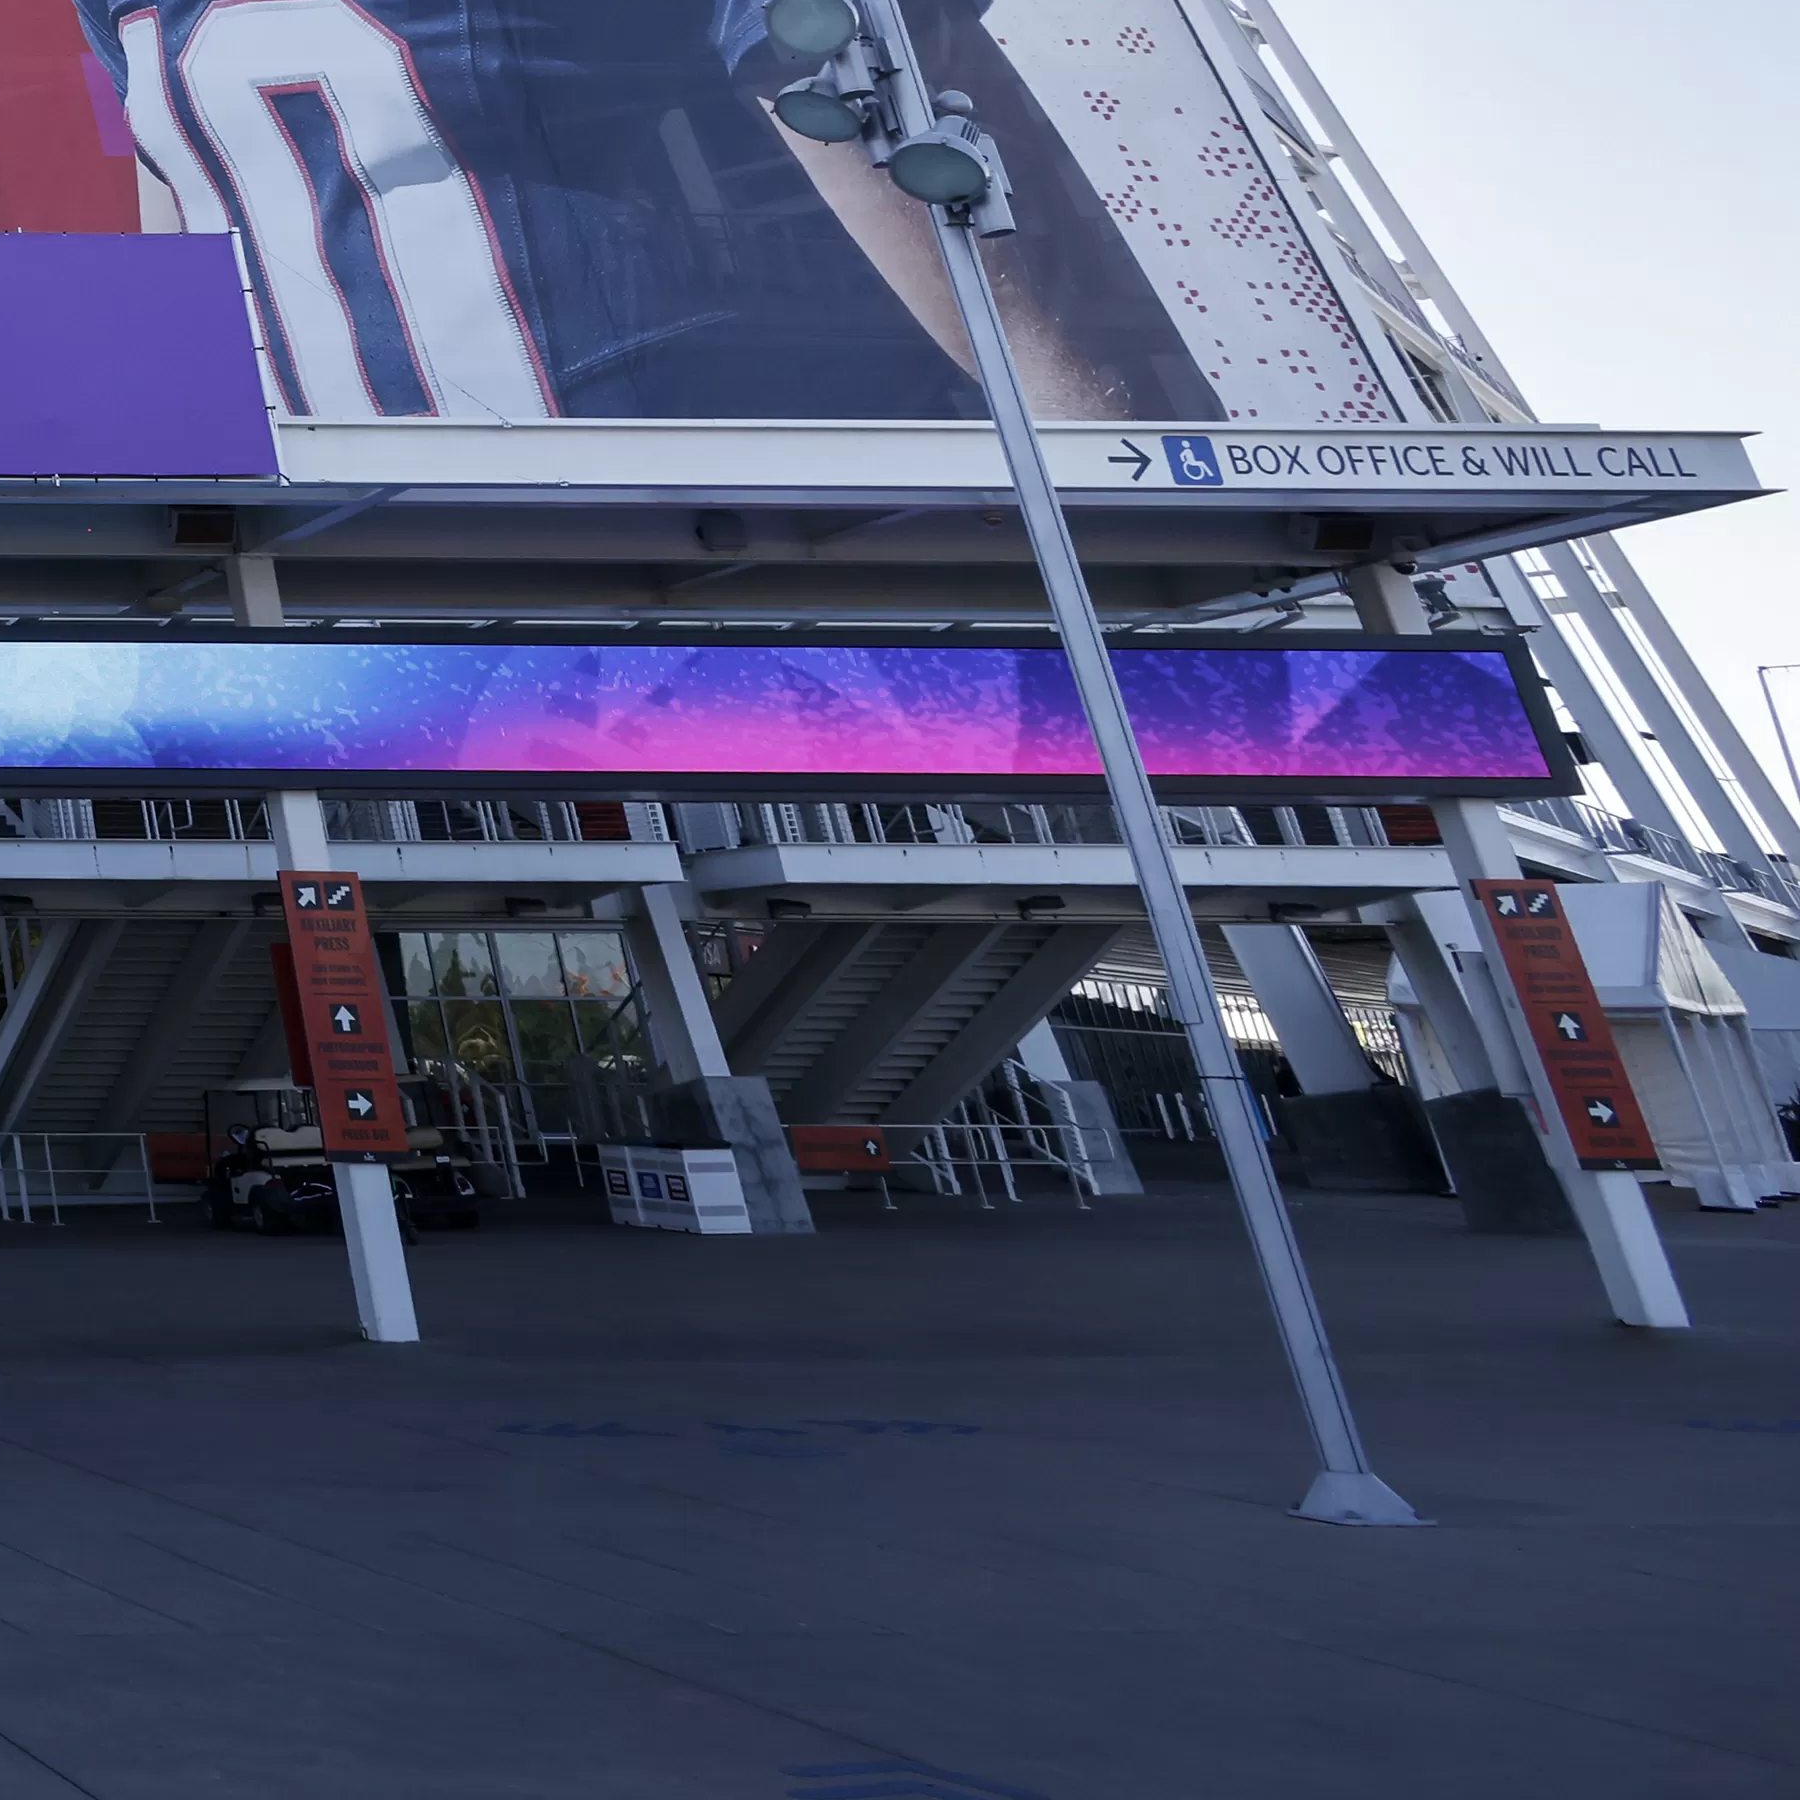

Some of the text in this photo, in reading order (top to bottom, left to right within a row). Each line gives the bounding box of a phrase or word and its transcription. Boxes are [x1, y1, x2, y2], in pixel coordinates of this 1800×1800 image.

[1226, 444, 1698, 479] BOX OFFICE & WILL CALL
